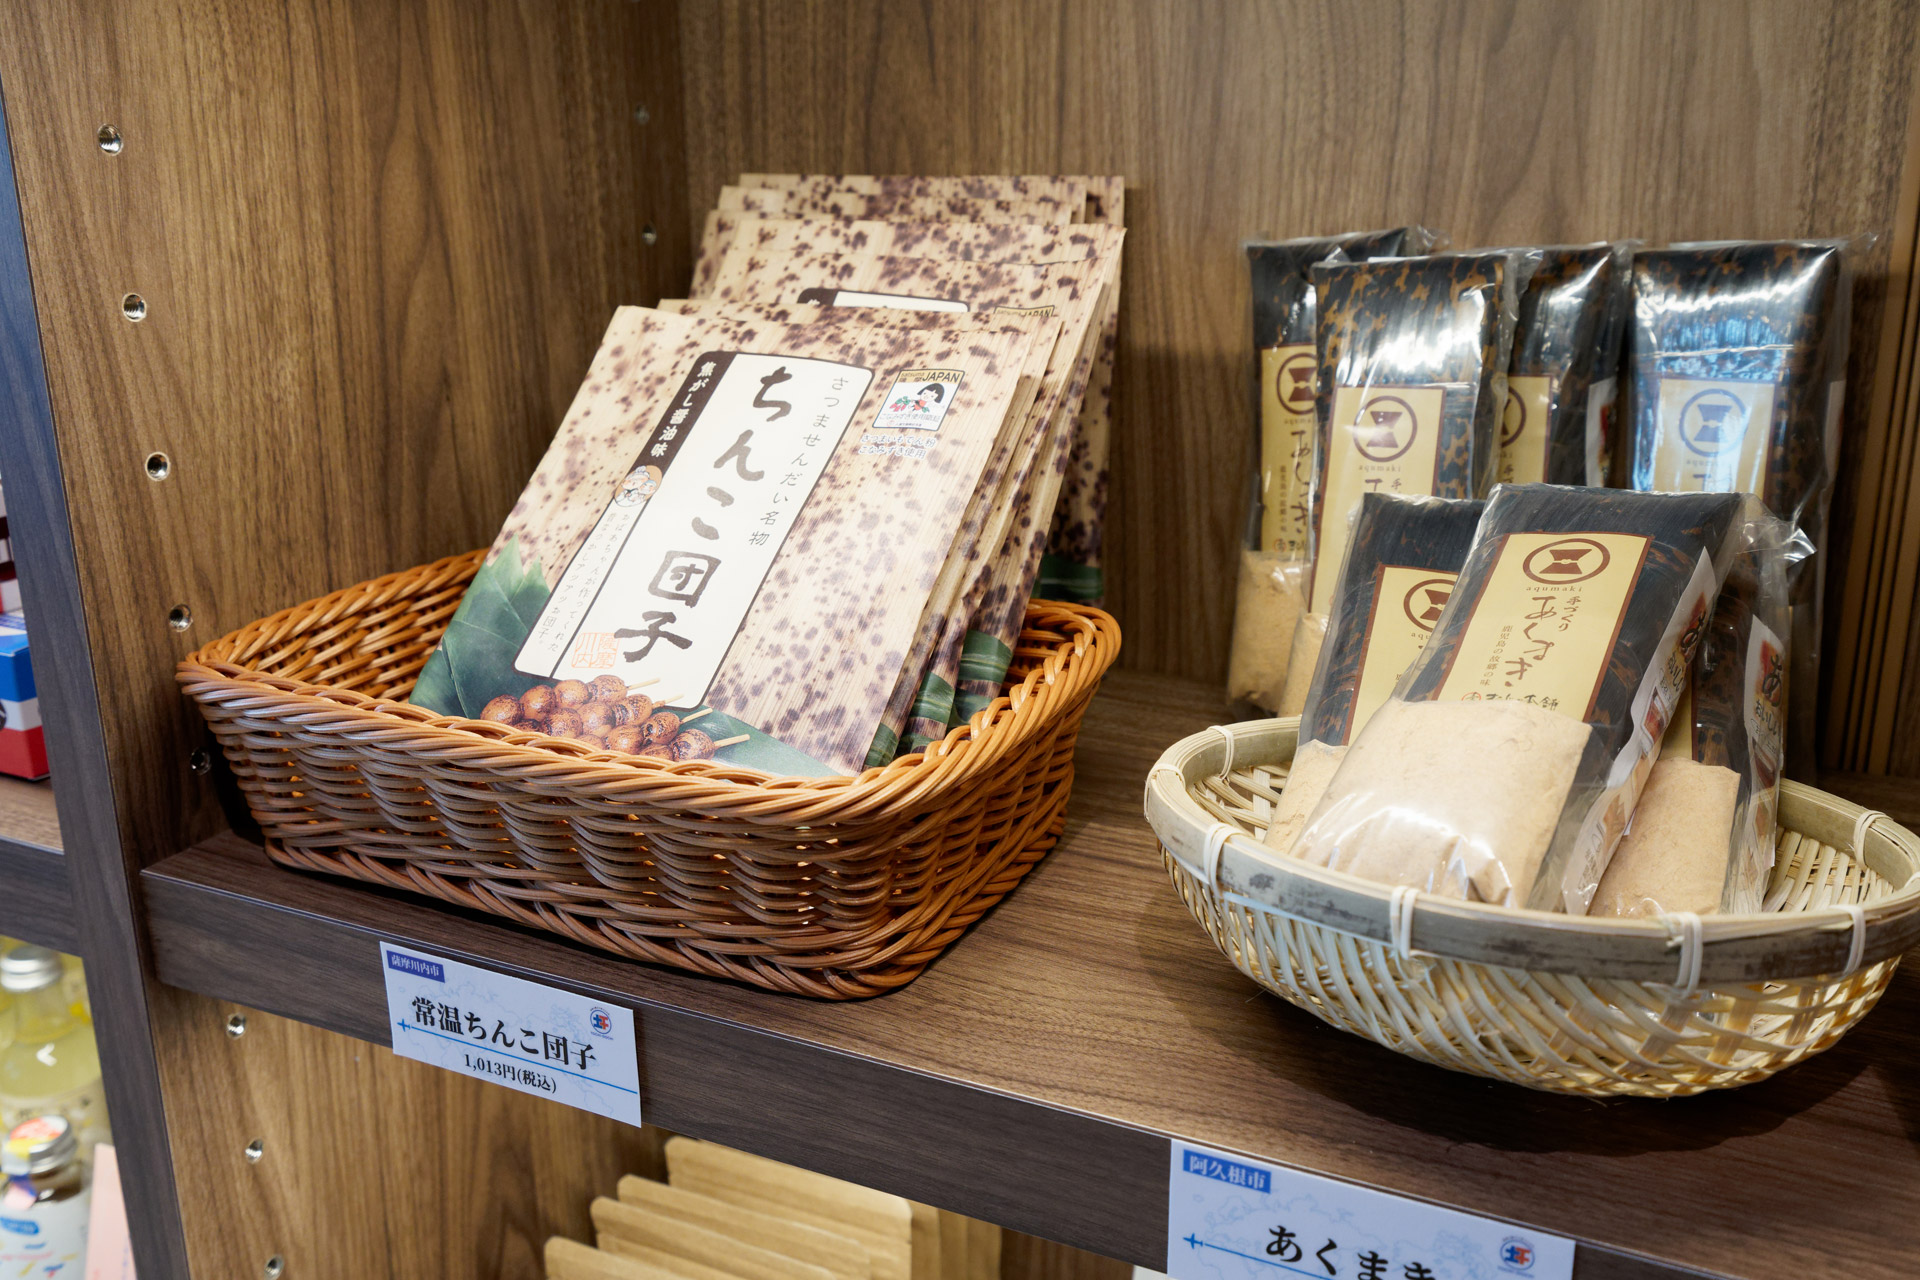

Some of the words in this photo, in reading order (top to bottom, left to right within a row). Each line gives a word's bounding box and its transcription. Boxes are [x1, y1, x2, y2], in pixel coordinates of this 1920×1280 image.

[922, 371, 961, 383] JAPAN
[650, 361, 717, 458] 焦がし醤油味
[748, 377, 848, 546] さつませんだい名物
[1358, 464, 1402, 473] aqumaki
[613, 366, 793, 663] ちんこ団子
[549, 514, 630, 652] おばあちゃんが作ってくれた
[1525, 585, 1583, 593] aqumaki
[1558, 595, 1582, 632] 手づくり
[1479, 625, 1514, 686] 鹿児島の故郷の味
[1504, 595, 1557, 687] あくまき
[390, 953, 440, 977] 薩摩川内市
[411, 995, 596, 1070] 常温ちんこ団子
[464, 1053, 557, 1094] 1,013円(税込)
[1188, 1154, 1267, 1191] 阿久根市
